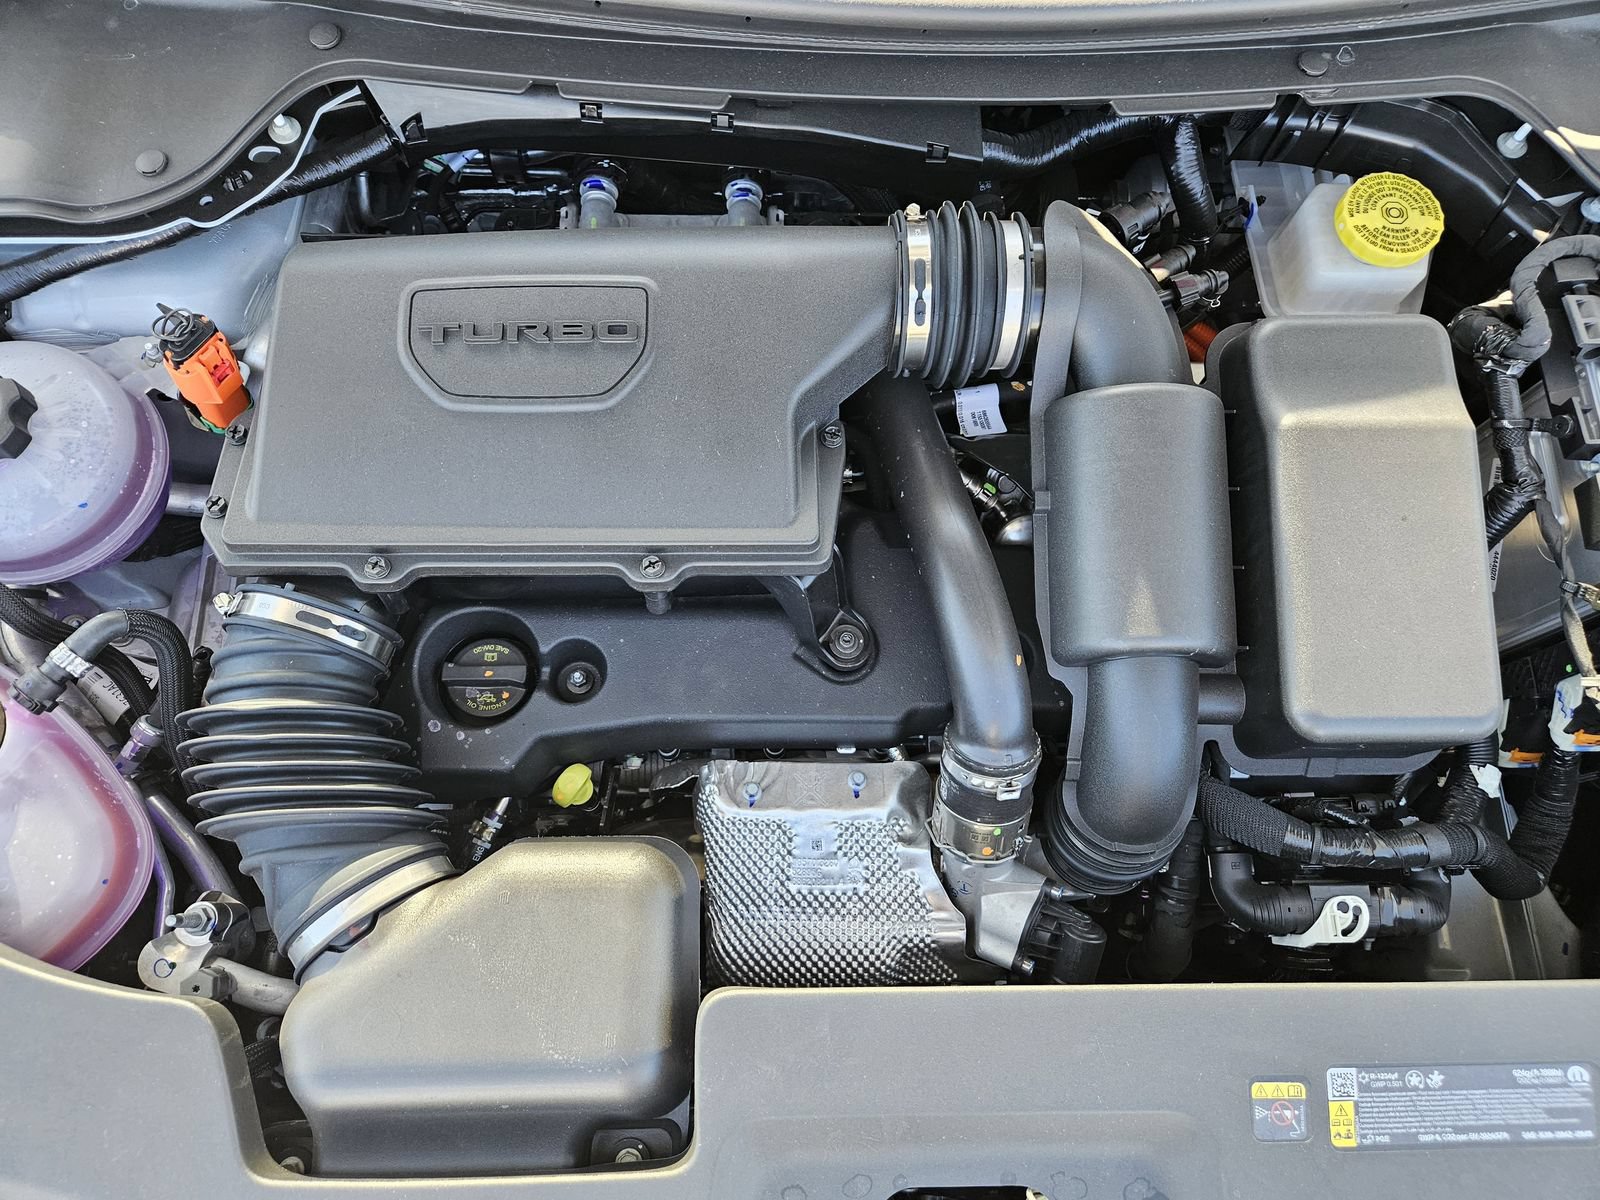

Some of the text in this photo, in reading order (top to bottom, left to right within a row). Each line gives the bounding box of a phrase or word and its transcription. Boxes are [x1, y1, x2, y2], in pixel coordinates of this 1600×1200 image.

[1347, 207, 1355, 217] MISE
[1360, 175, 1384, 185] NETTOYER
[1392, 174, 1417, 187] BOUCHON
[1424, 191, 1441, 222] REMPLISSAGE
[1363, 191, 1376, 206] LIQUIDE
[1392, 187, 1421, 204] PROVENANT
[1370, 193, 1396, 210] CONTENANT
[1390, 180, 1412, 190] UTILISER
[1413, 189, 1433, 217] UNIQUEMENT
[1353, 225, 1363, 234] DOT
[1364, 236, 1379, 247] FLUID
[1379, 244, 1394, 252] FROM
[1400, 245, 1419, 253] SEALED
[1360, 224, 1380, 240] BEFORE
[1411, 236, 1422, 245] USE
[1421, 226, 1431, 238] ONLY
[1373, 227, 1390, 238] CLEAN
[1410, 229, 1419, 237] CAP
[417, 319, 639, 344] TURBO
[1490, 550, 1500, 580] 4444020
[473, 644, 510, 655] SAE 0W-20
[466, 699, 506, 711] ENGINE OIL
[472, 846, 485, 862] ENG
[1370, 1080, 1385, 1088] GWP
